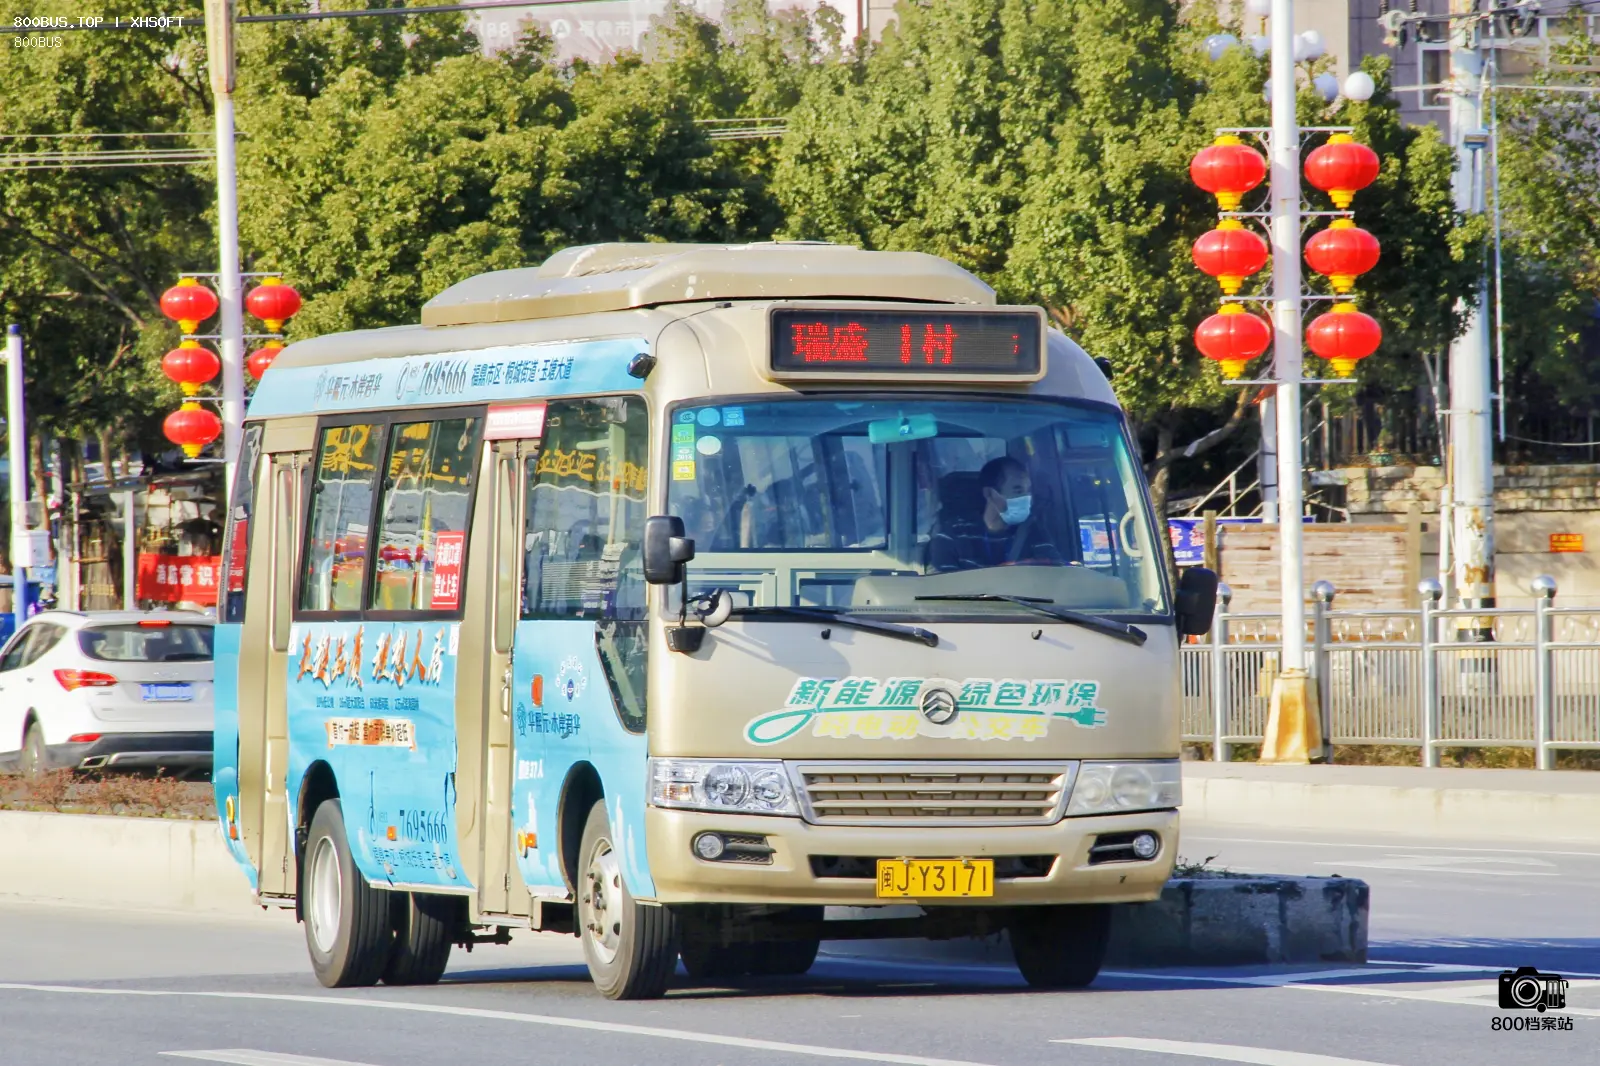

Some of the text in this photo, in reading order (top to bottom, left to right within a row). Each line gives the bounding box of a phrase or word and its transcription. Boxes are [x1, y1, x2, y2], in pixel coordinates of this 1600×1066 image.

[789, 678, 1097, 707] 新能源 绿色环保
[399, 809, 449, 845] 7695666
[881, 864, 987, 892] 闽J·Y3171
